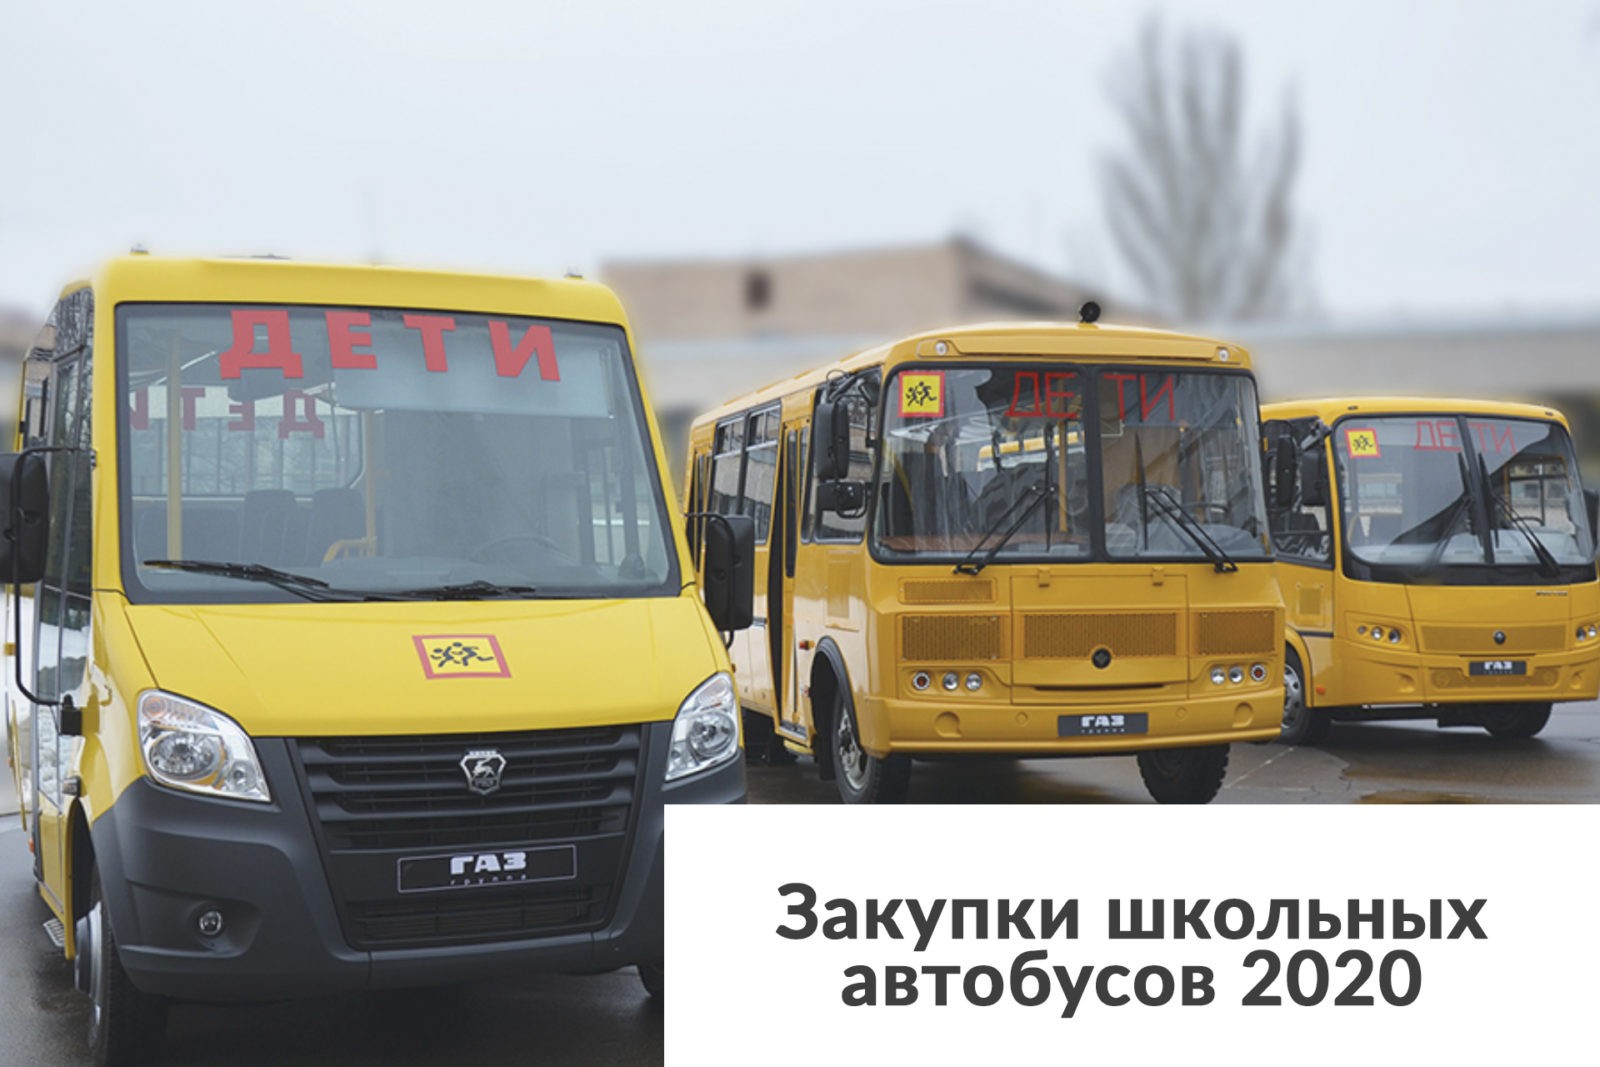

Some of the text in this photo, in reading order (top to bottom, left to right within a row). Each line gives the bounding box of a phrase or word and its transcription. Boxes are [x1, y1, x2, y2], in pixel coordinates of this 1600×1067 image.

[219, 309, 560, 382] ДЕТИ
[1081, 715, 1125, 727] ГАЗ
[450, 852, 527, 875] ГАЗ
